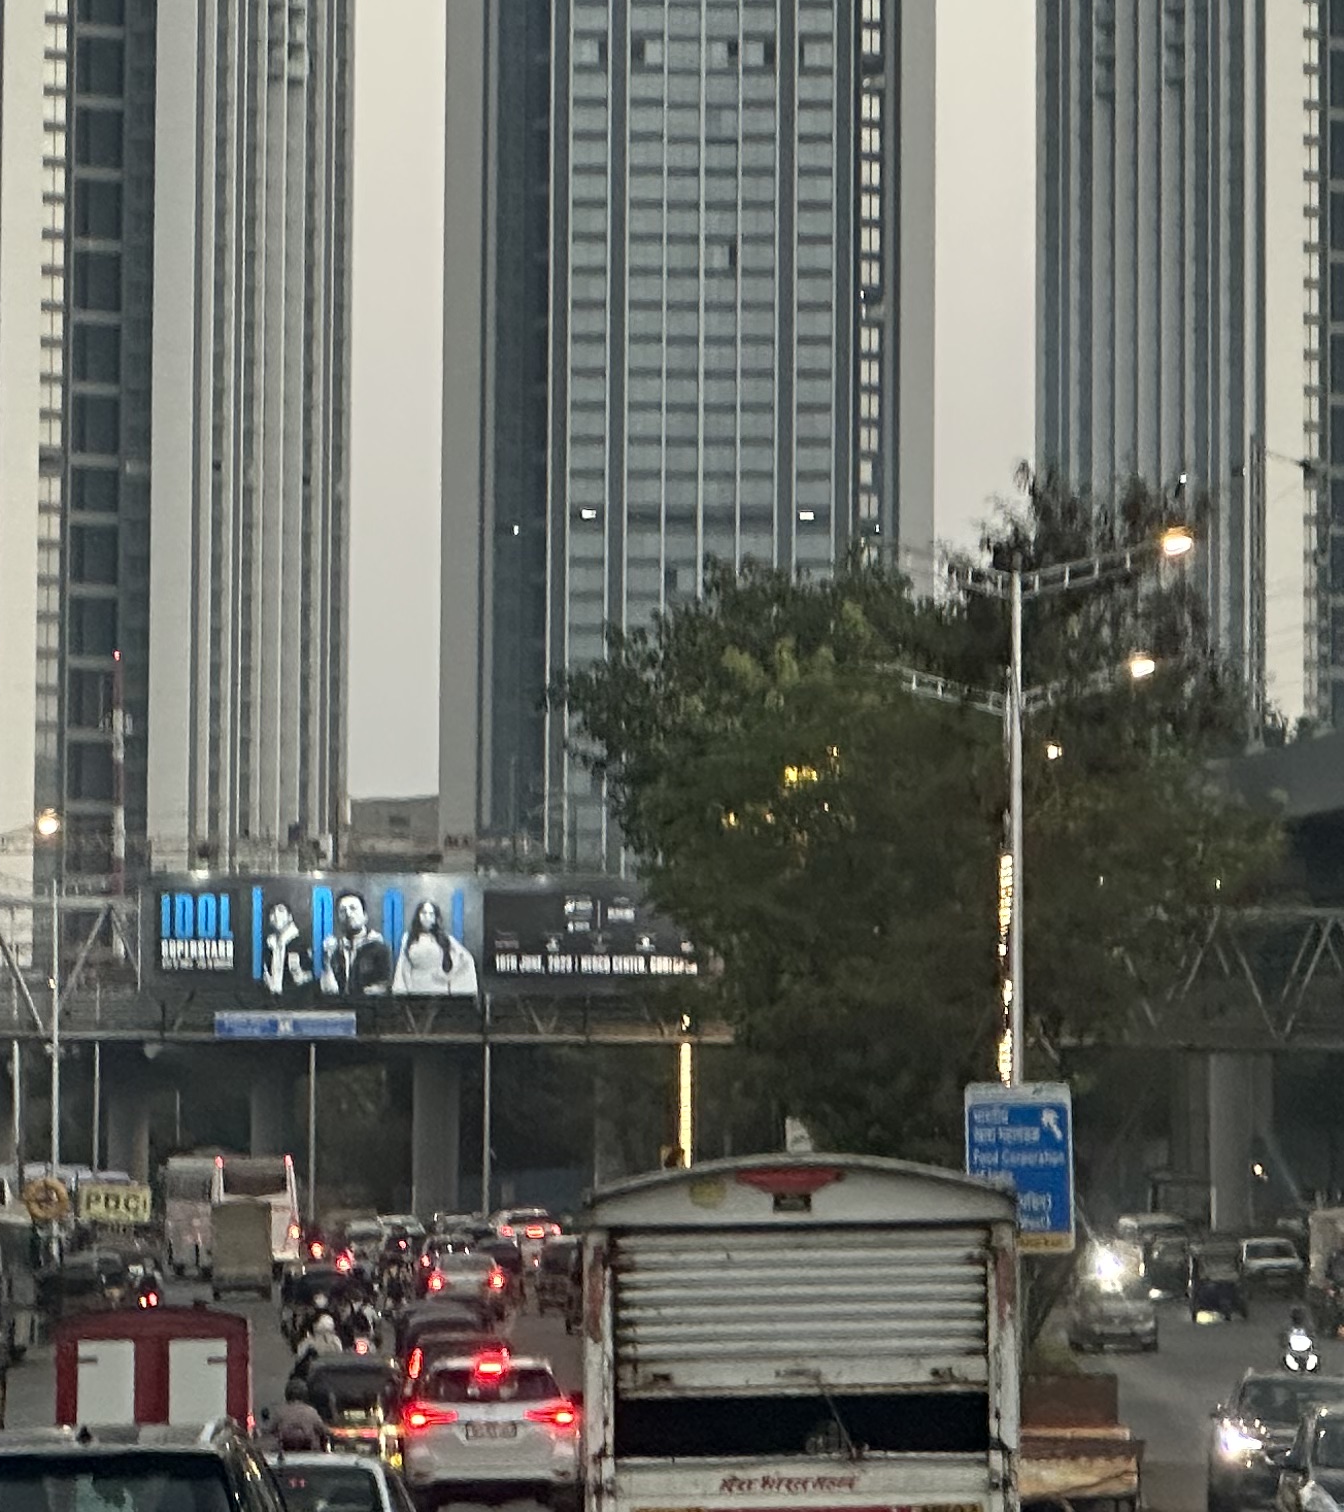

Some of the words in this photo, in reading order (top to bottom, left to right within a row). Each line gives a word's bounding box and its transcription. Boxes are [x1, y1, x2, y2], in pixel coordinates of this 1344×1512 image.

[161, 892, 234, 939] IDOL
[973, 1148, 999, 1167] Food
[1002, 1148, 1066, 1168] Corporation
